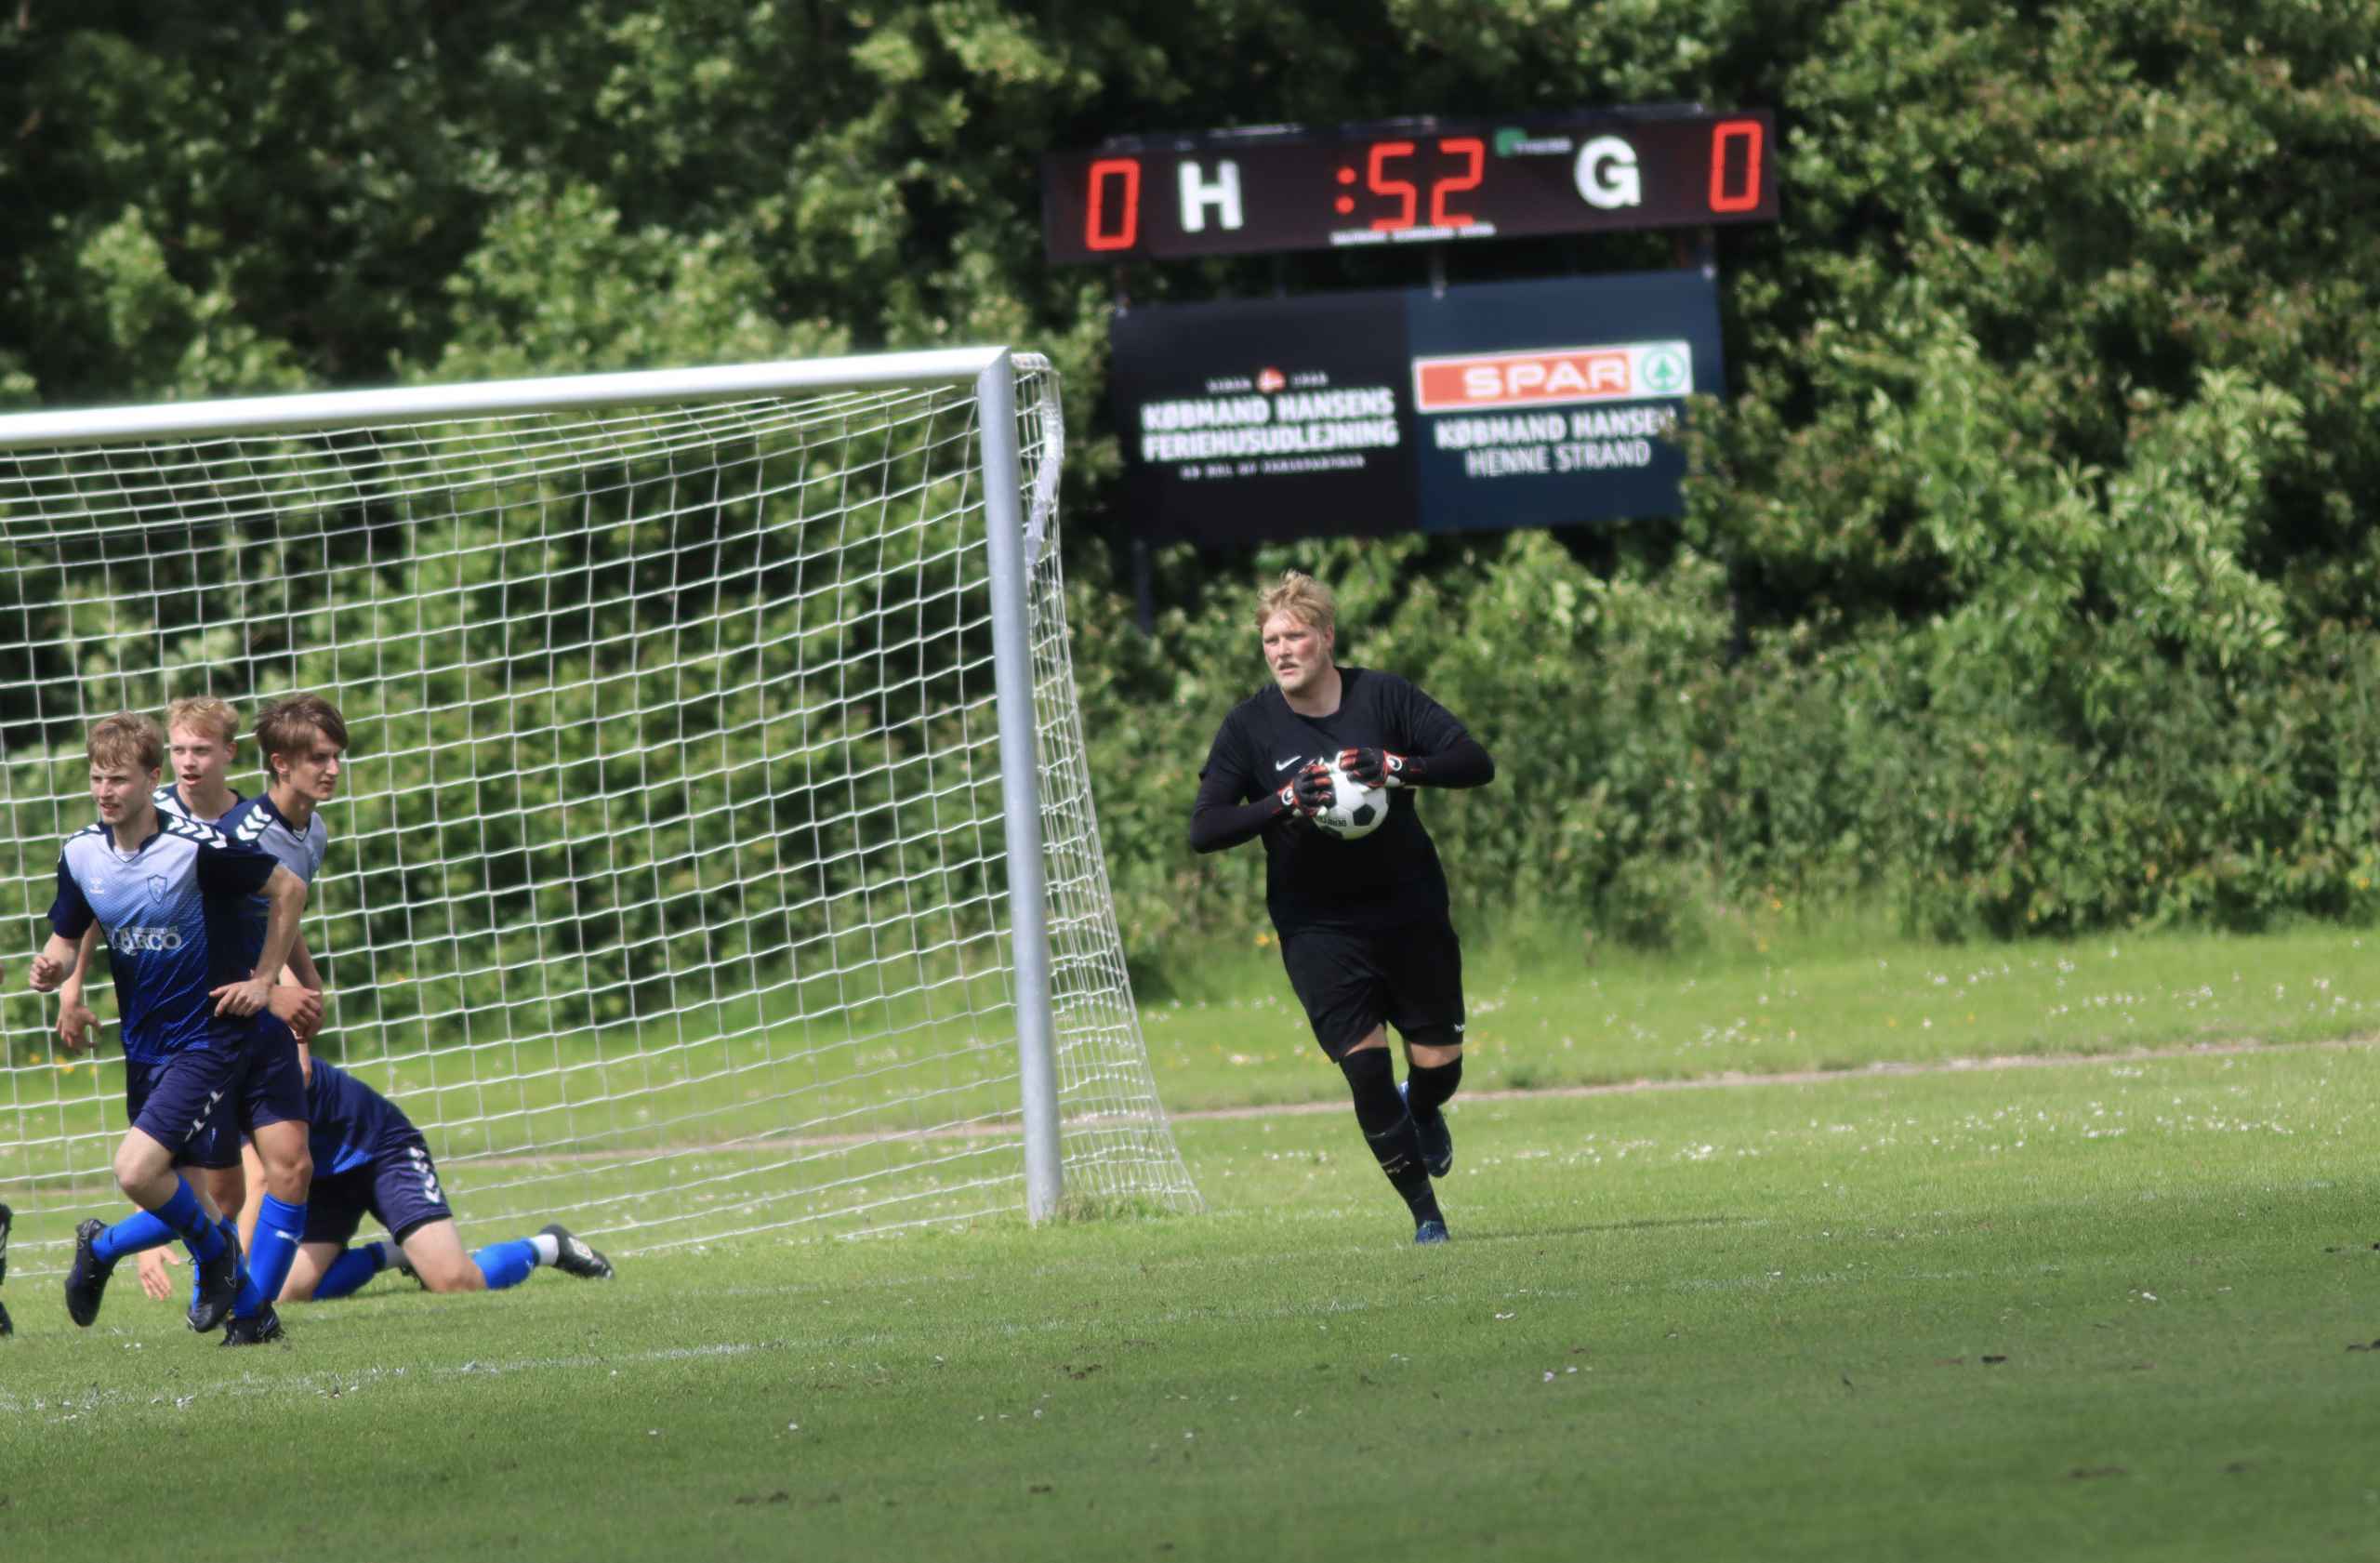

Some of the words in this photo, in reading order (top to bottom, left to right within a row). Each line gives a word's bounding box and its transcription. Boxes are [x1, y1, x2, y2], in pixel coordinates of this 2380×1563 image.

[1574, 135, 1641, 209] G
[1710, 120, 1763, 212] 0
[1086, 158, 1140, 251] 0
[1179, 160, 1243, 232] H
[1463, 359, 1625, 398] SPAR
[1142, 396, 1271, 430] KØBMAND
[1276, 387, 1395, 421] HANSENS
[1435, 412, 1567, 449] KØBMAND
[1143, 418, 1399, 462] FERIEHUSUDLEJNING
[1465, 444, 1550, 477] HENNE
[1554, 438, 1651, 472] STRAND
